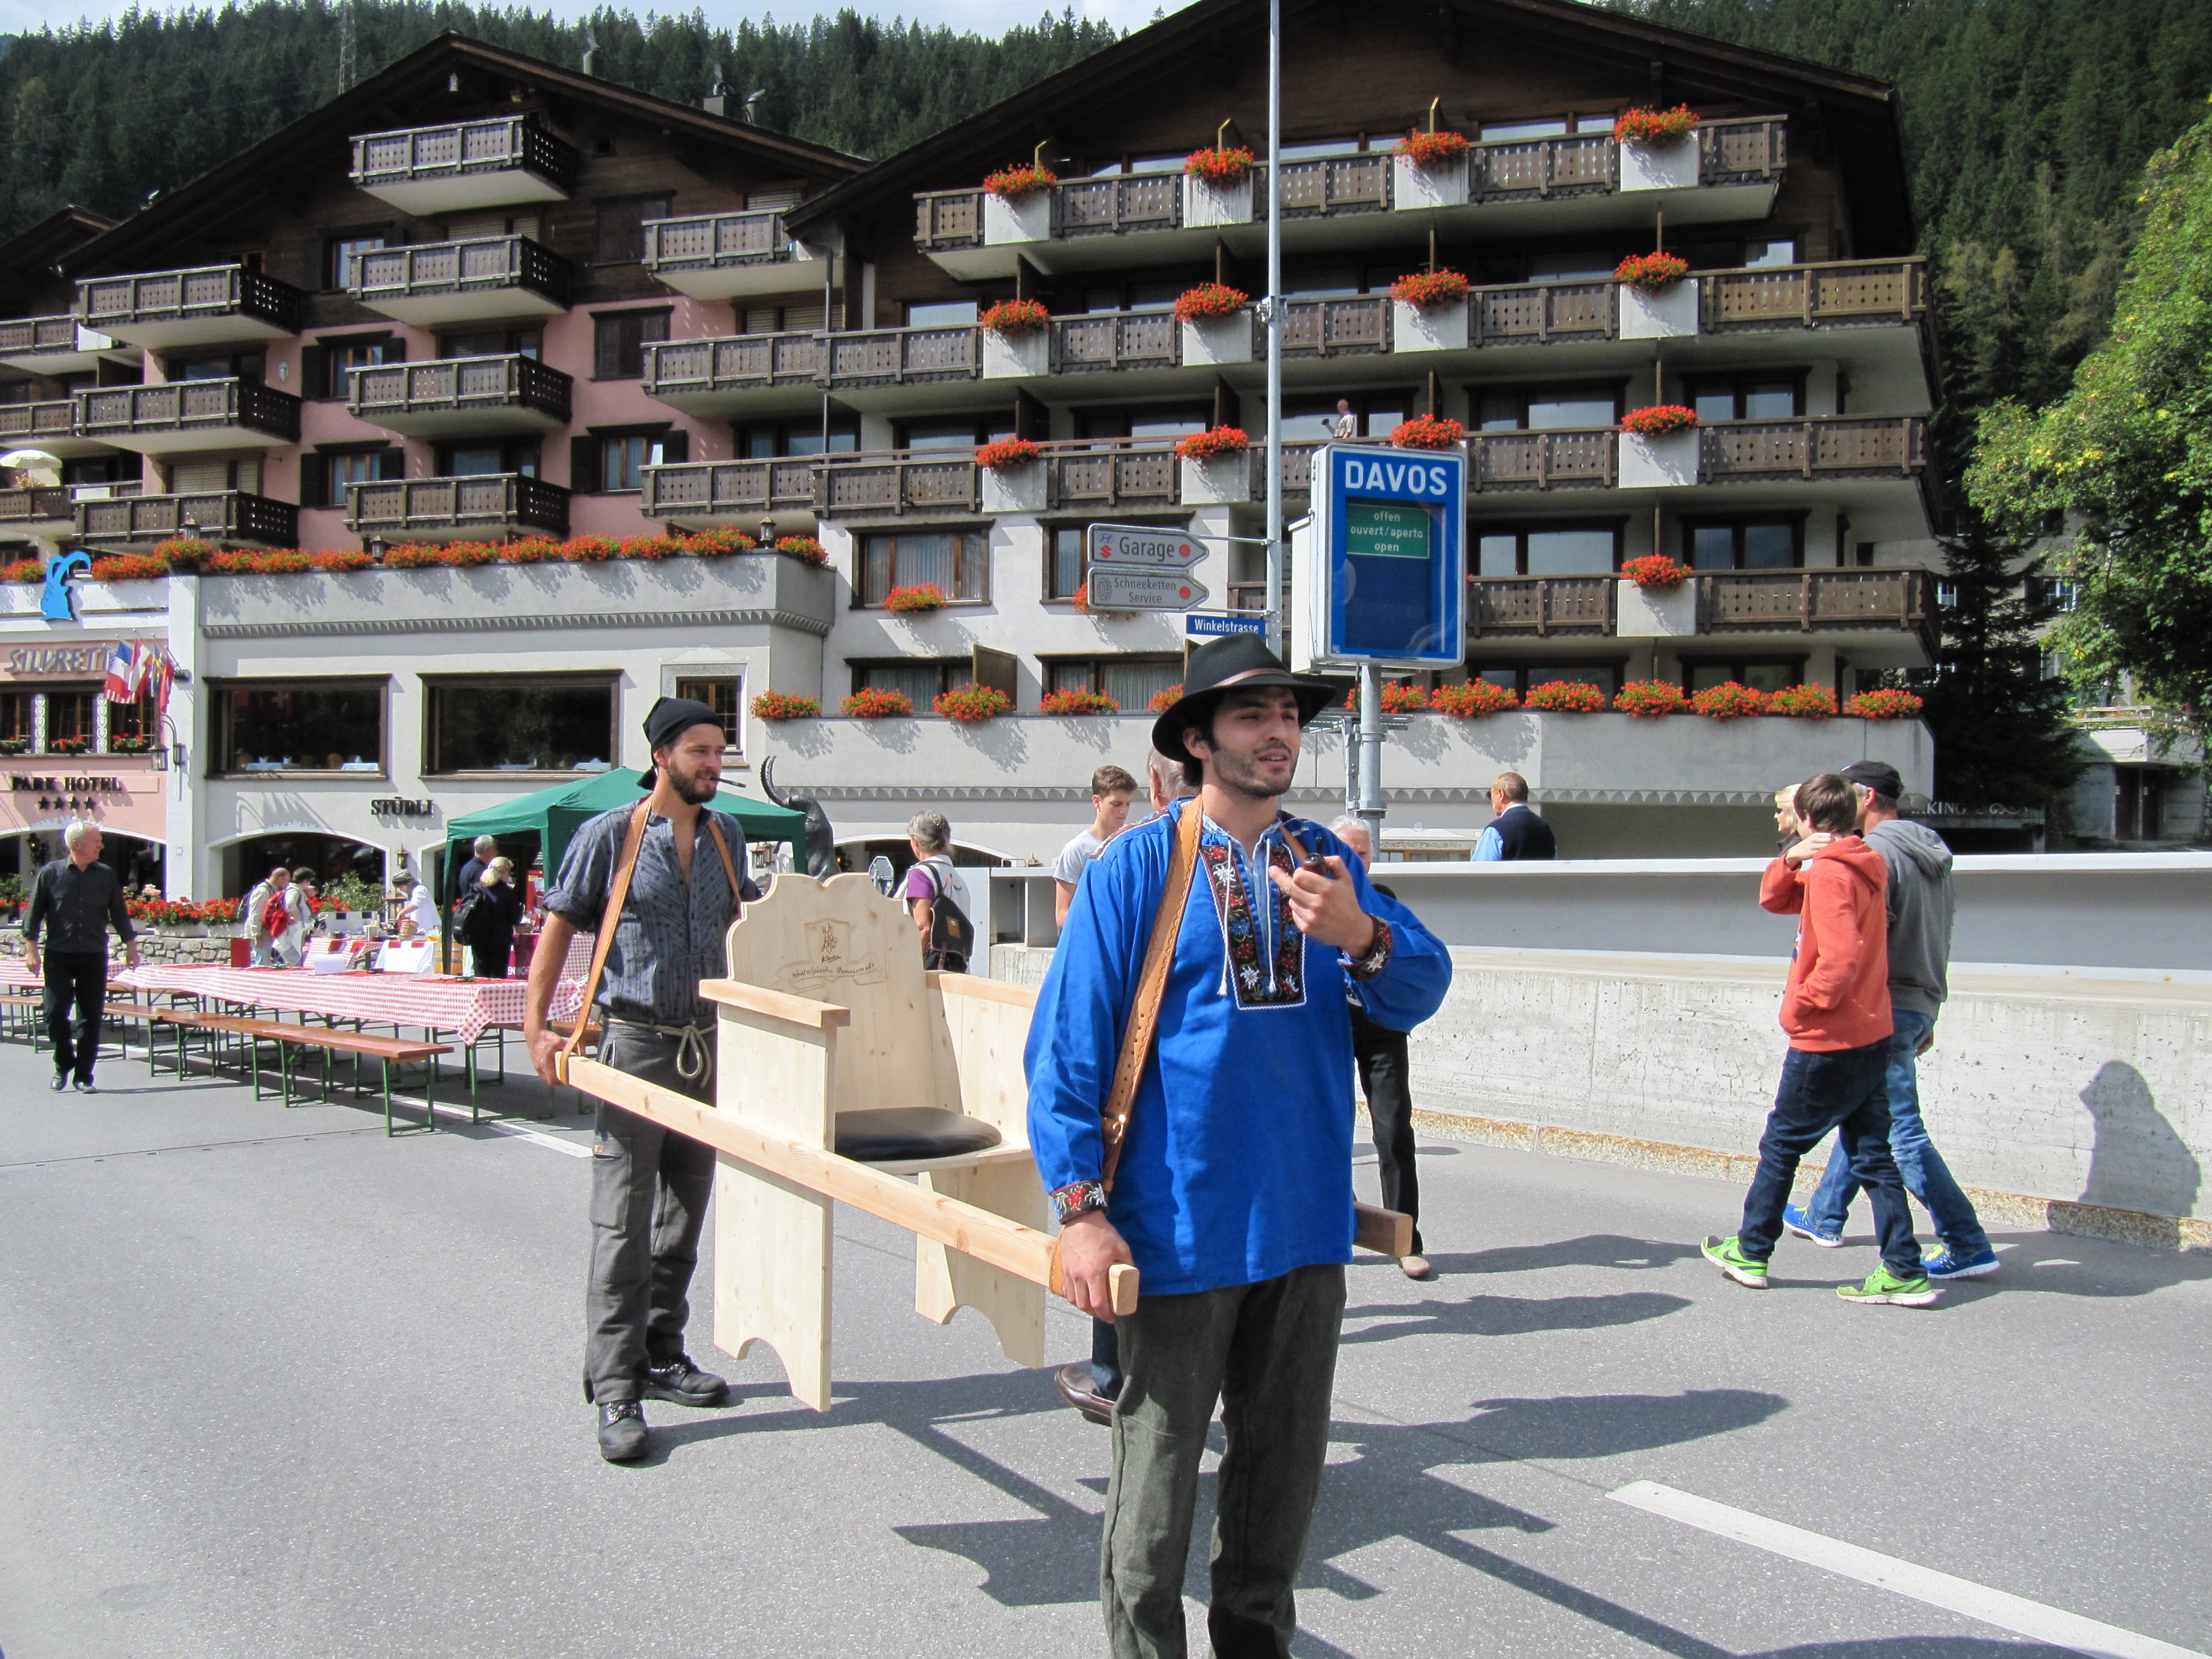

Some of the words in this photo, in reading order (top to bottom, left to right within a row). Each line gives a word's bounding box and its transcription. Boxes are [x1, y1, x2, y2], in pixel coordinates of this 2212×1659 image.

[1345, 460, 1447, 495] DAVOS
[1374, 511, 1401, 522] offen
[1119, 536, 1175, 562] Garage
[1374, 543, 1399, 553] open
[1114, 577, 1176, 591] Schneeketten
[1129, 592, 1162, 604] Service
[1194, 618, 1259, 634] Winkelstrasse
[4, 647, 113, 673] SILVRETT
[12, 776, 57, 792] PARK
[64, 776, 122, 792] HOTEL
